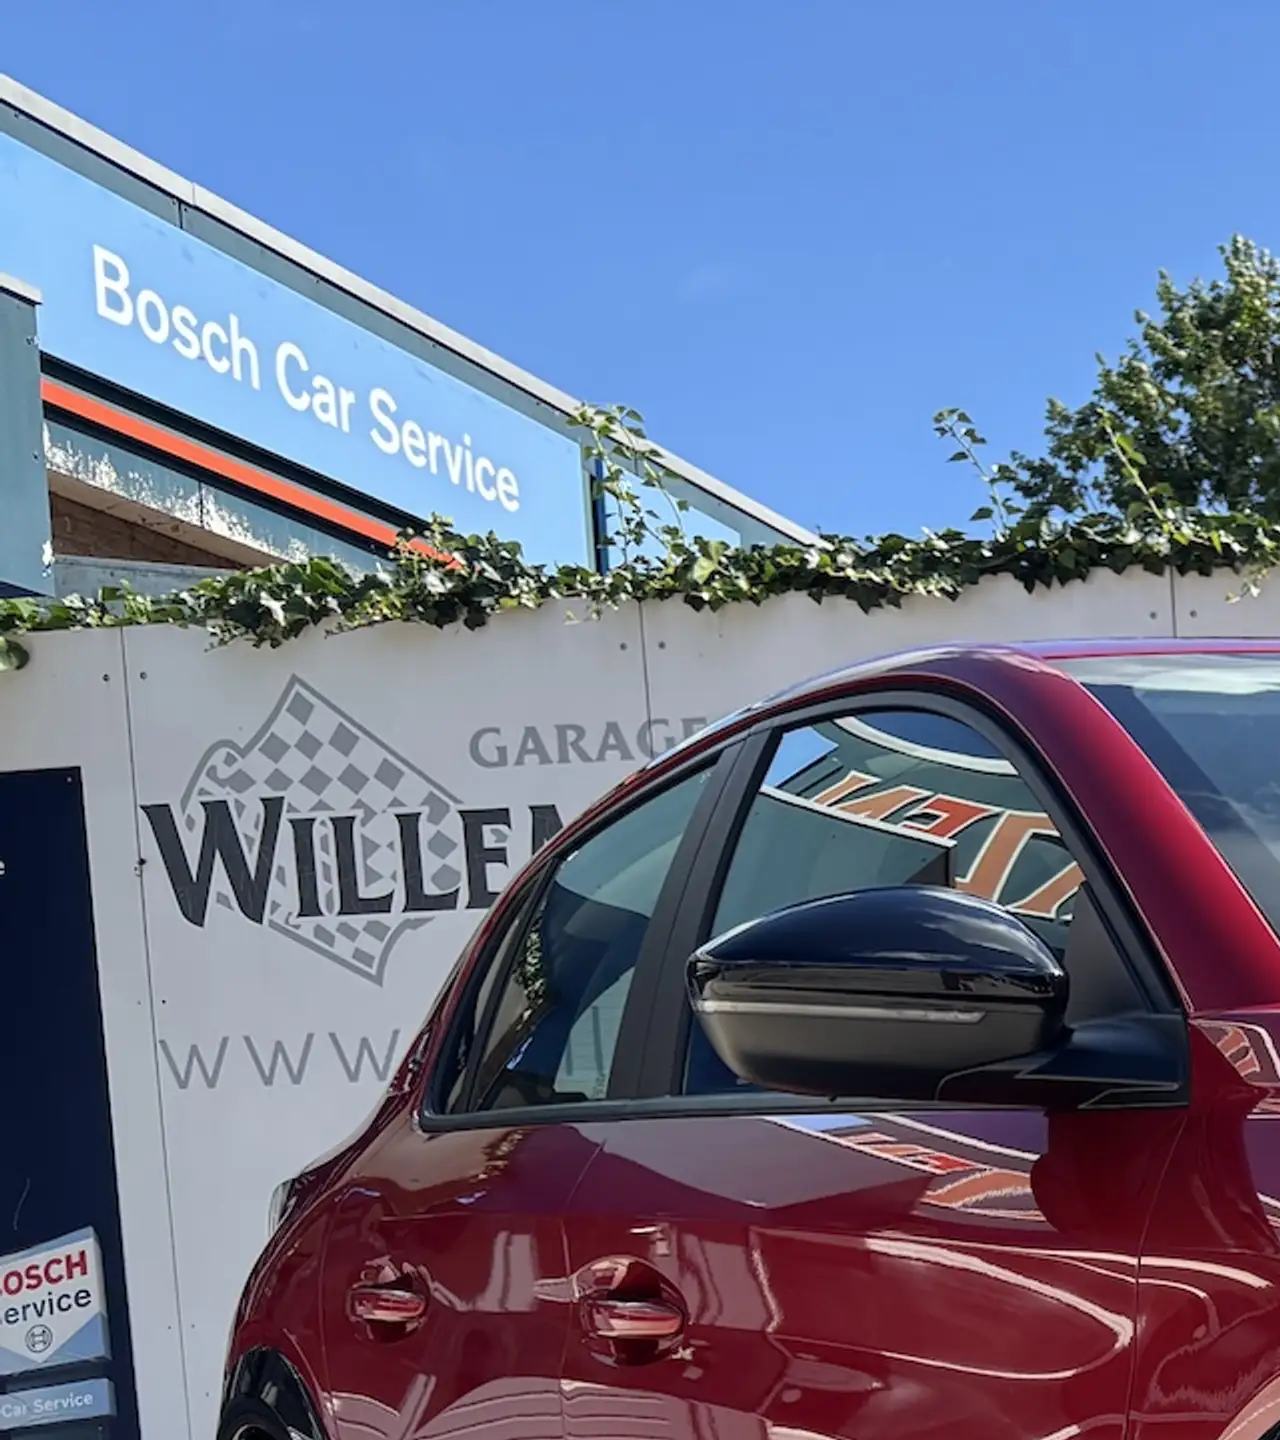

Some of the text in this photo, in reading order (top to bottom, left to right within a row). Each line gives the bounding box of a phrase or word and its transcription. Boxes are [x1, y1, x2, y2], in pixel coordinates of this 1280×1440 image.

[93, 243, 520, 513] Bosch Car Service
[0, 1249, 88, 1296] OSCH
[0, 1287, 92, 1326] ervice
[1, 1392, 94, 1418] Car Service
